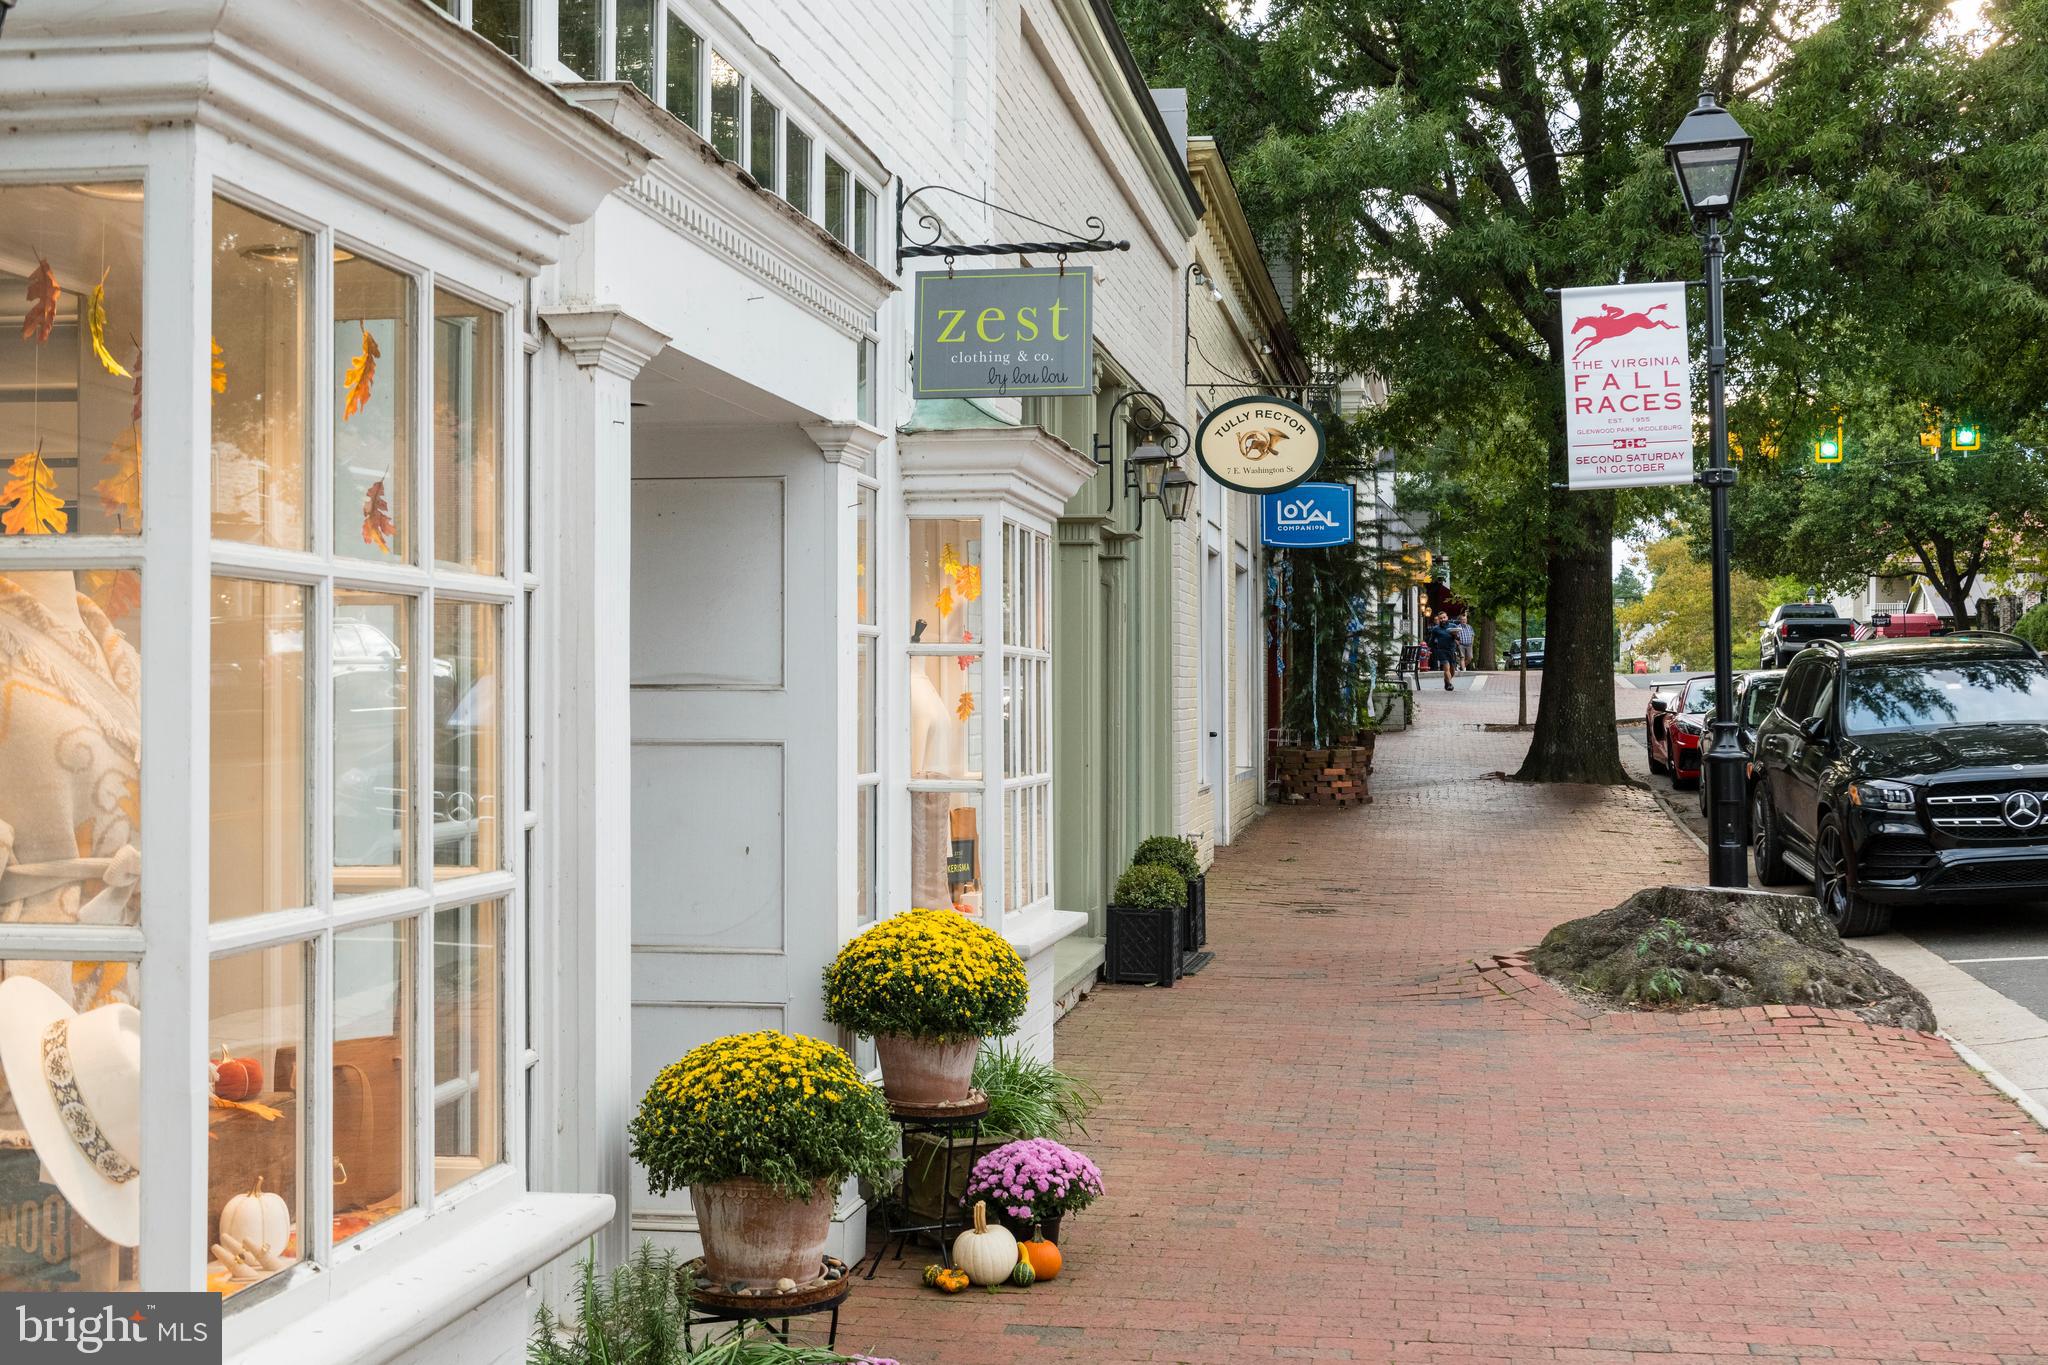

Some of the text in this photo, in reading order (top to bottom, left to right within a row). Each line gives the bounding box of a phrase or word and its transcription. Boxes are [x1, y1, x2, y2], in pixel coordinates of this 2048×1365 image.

[936, 297, 1070, 343] zest
[951, 350, 1054, 365] clothing & co.
[1572, 356, 1681, 371] THE VIRGINIA
[987, 366, 1069, 395] by lou lou
[1573, 370, 1681, 392] FALL
[1575, 392, 1682, 415] RACES
[1214, 409, 1307, 439] TULLY RECTOR
[1576, 426, 1615, 435] GLENWOOD
[1576, 452, 1685, 465] SECOND SATURDAY
[1227, 467, 1231, 475] 7
[1243, 466, 1285, 476] Washington
[1596, 463, 1665, 474] IN OCTOBER
[1277, 499, 1340, 527] LOYAL
